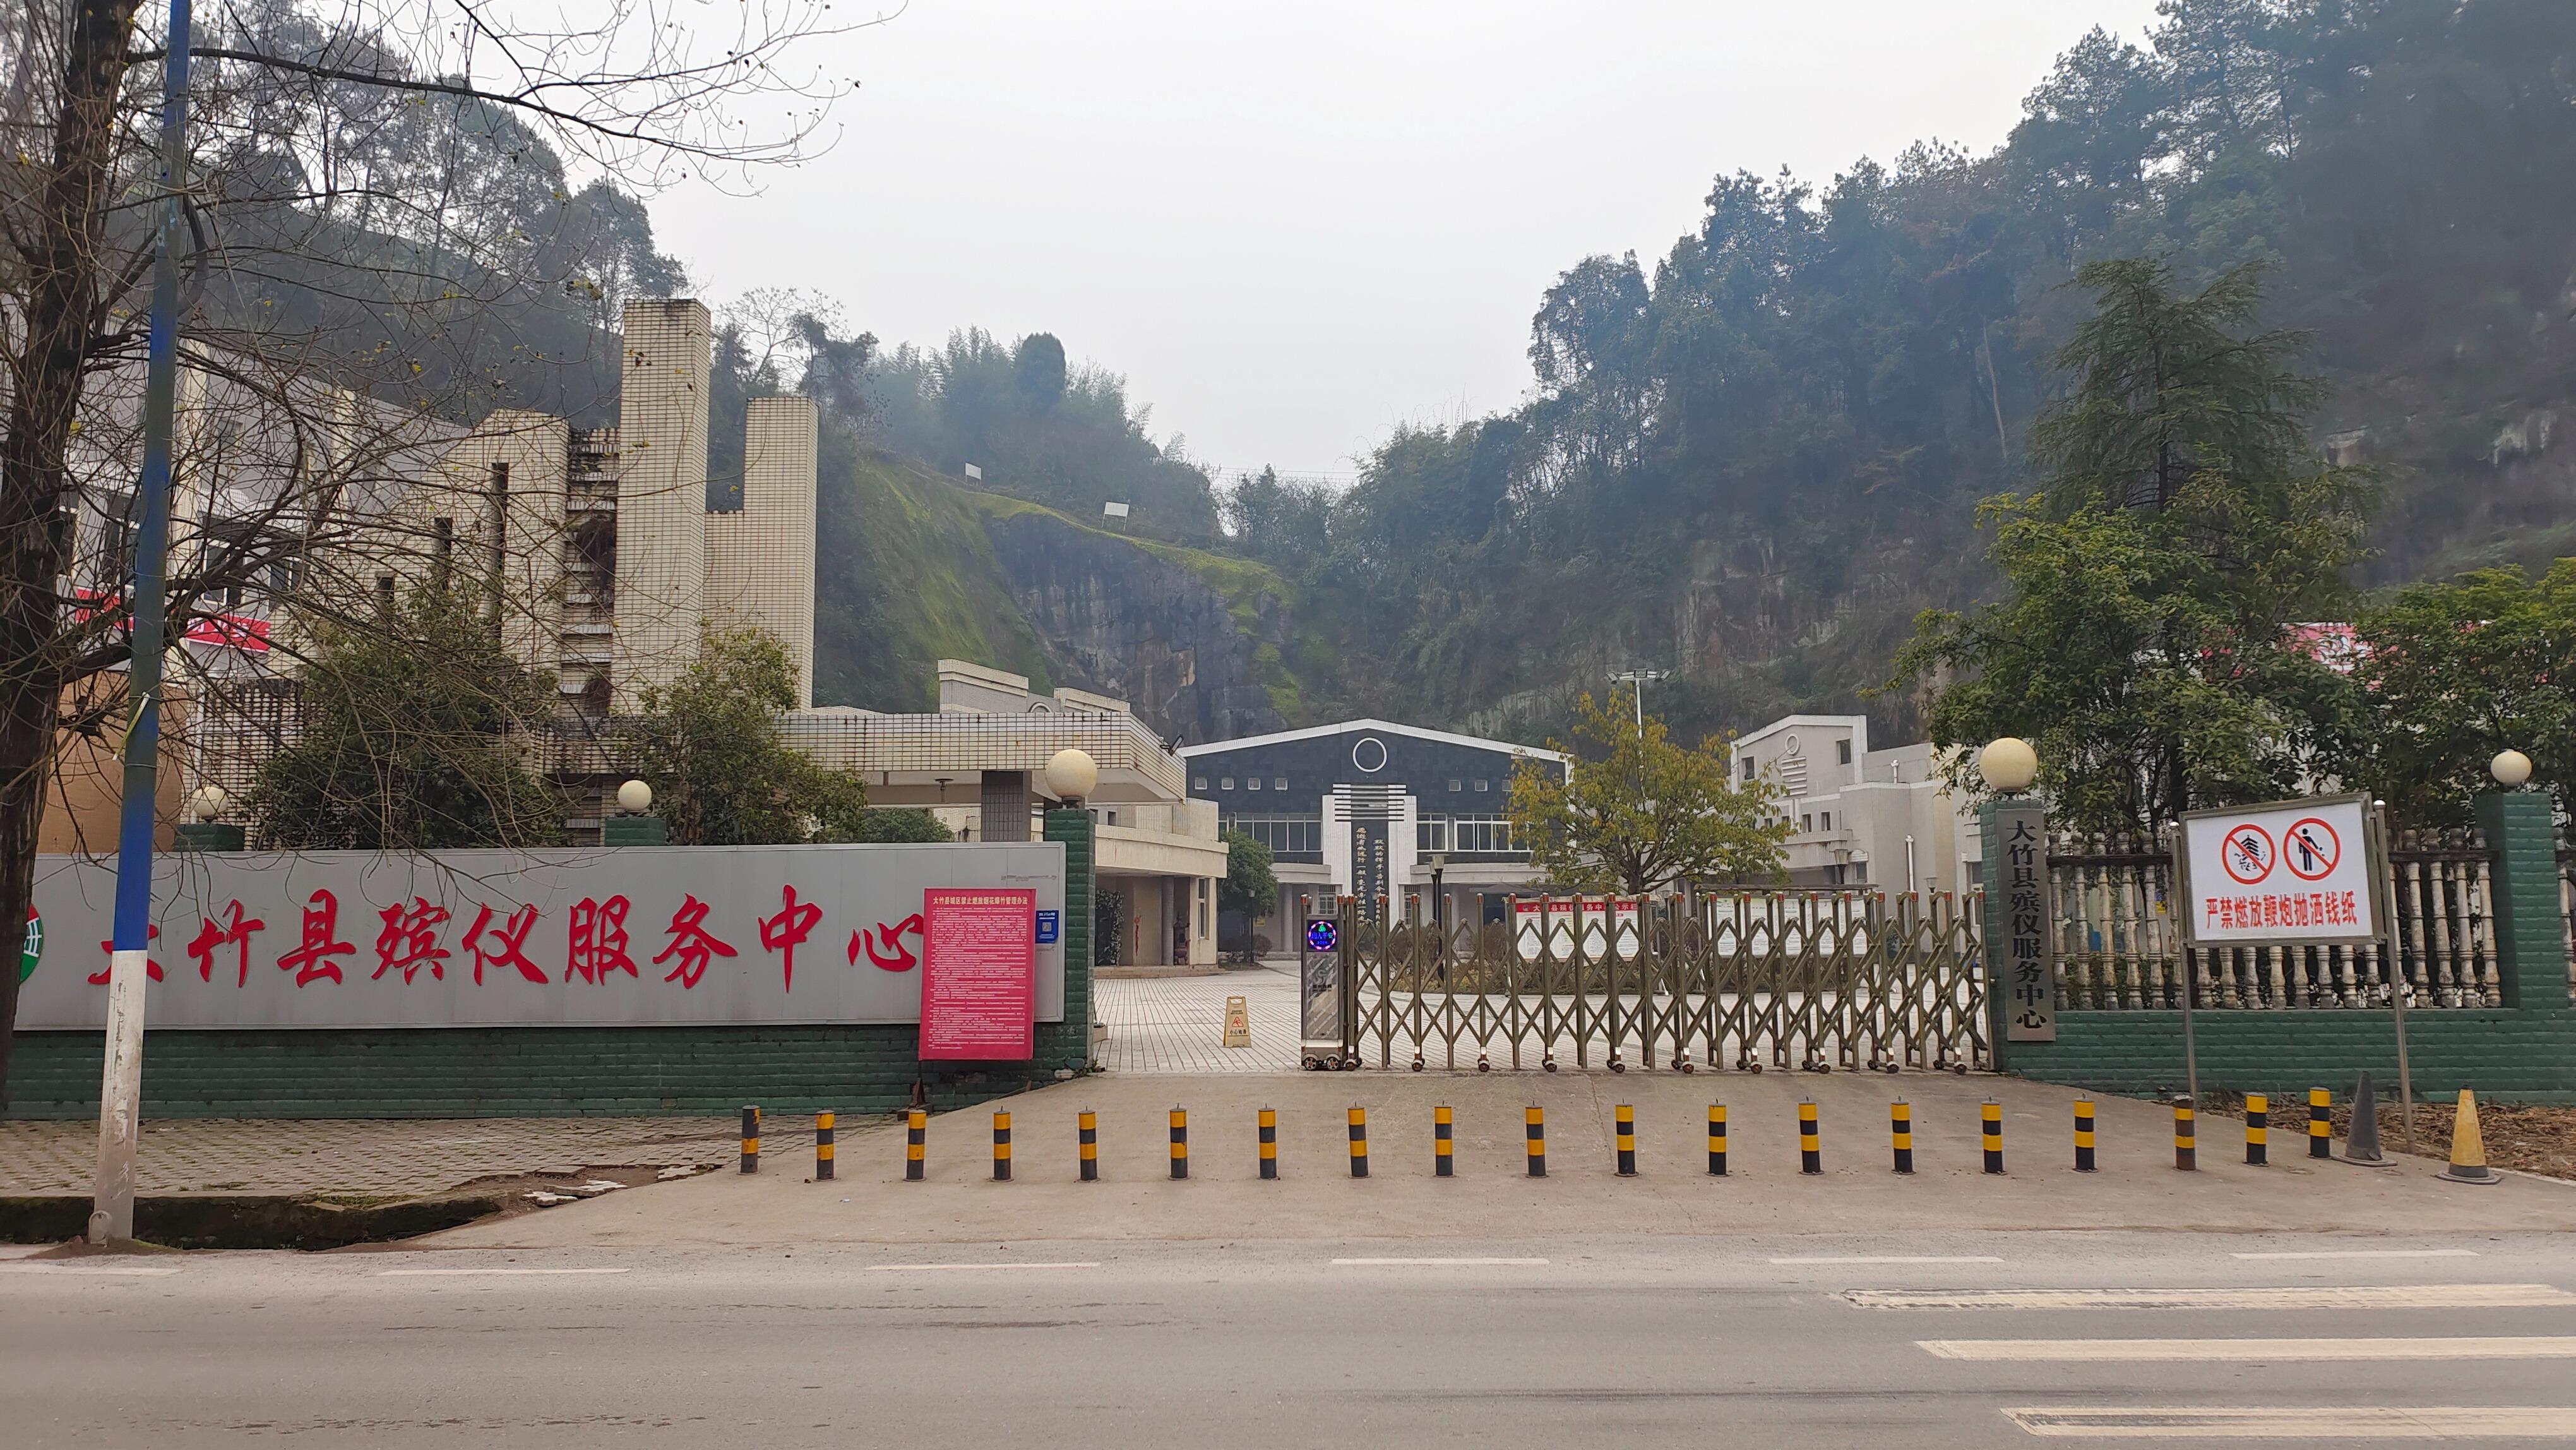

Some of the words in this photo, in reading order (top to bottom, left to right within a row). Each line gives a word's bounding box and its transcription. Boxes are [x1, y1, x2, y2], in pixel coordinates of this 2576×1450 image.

[1533, 902, 1637, 911] 大县殡仪务中公示栏
[2007, 820, 2048, 1029] 大竹县殡仪服务中心
[2205, 890, 2357, 930] 严禁燃放鞭炮抛洒钱纸
